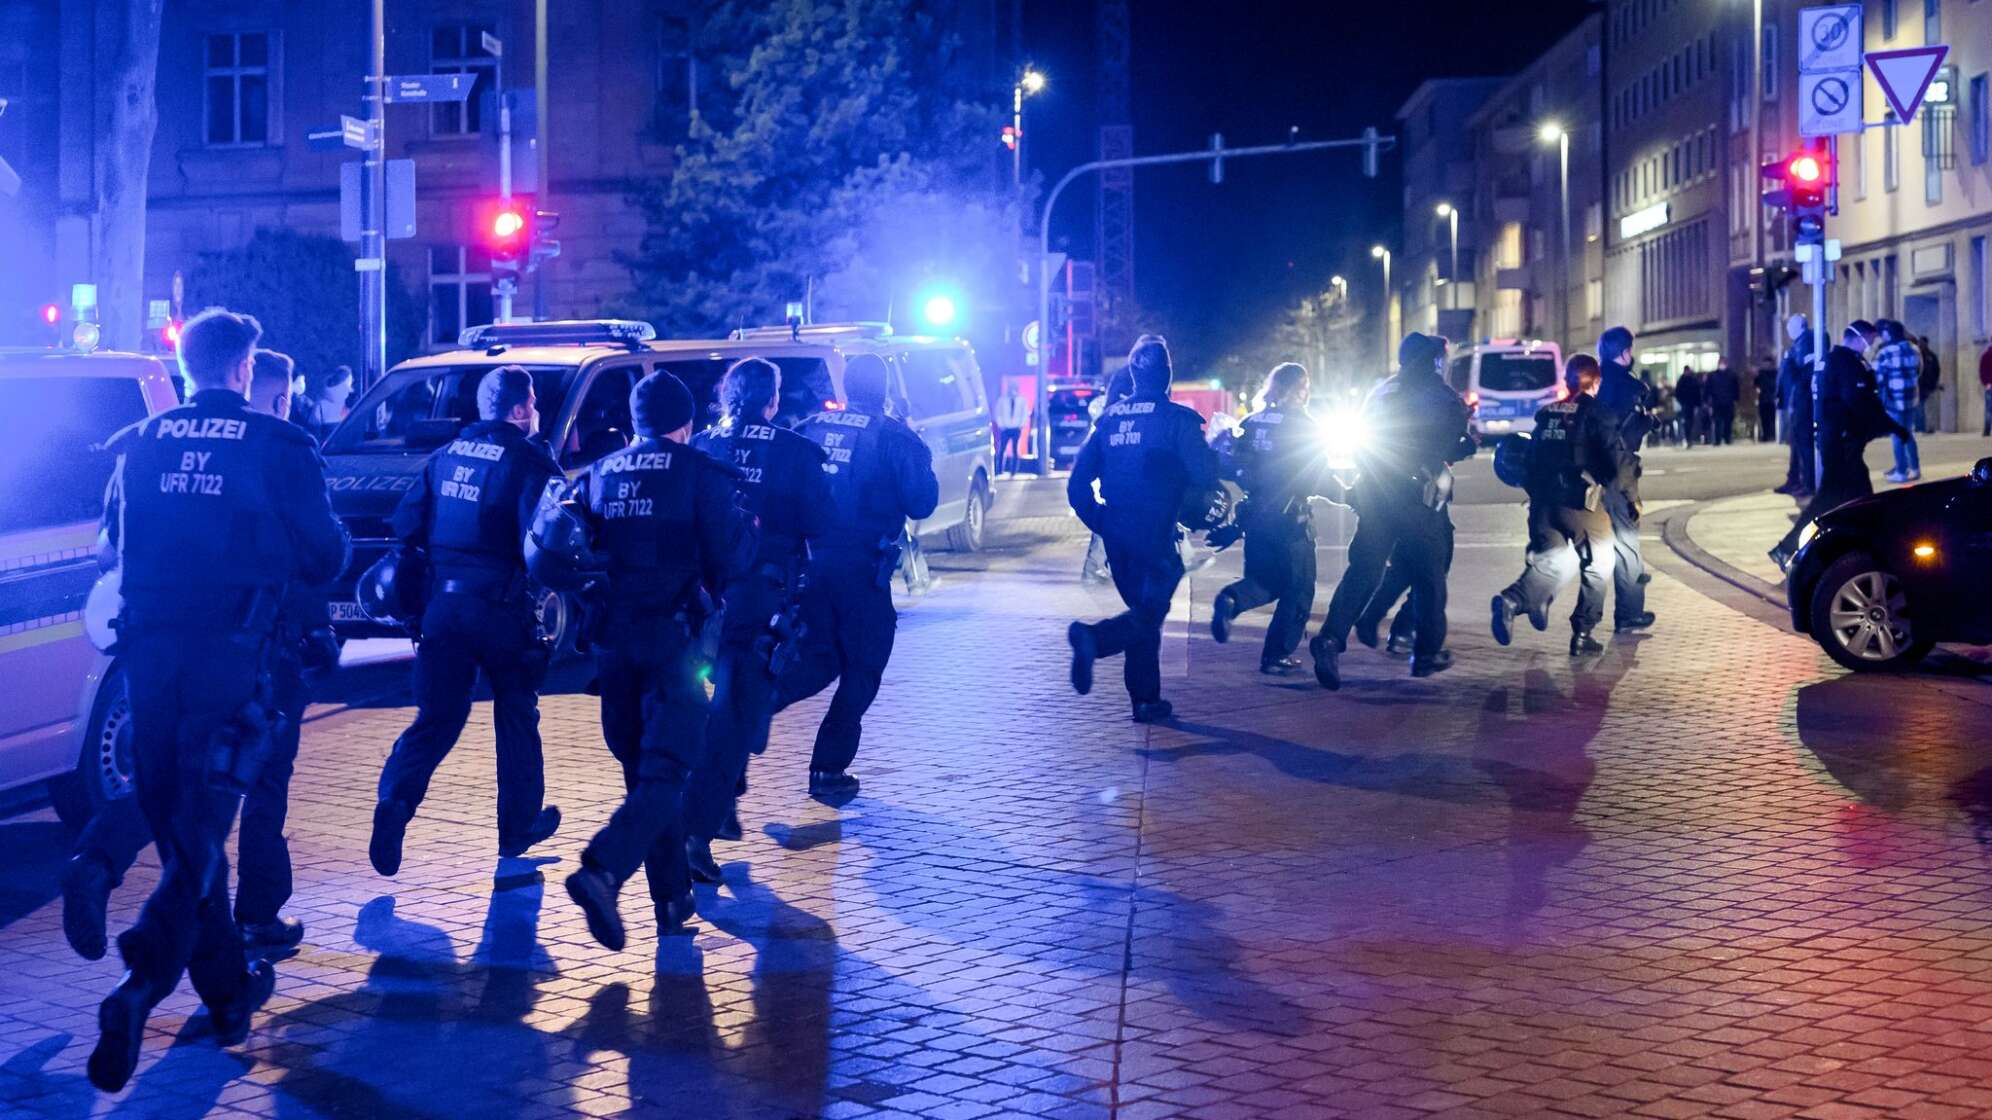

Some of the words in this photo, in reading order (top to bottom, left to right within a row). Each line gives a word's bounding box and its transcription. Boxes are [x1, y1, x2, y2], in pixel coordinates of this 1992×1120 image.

[1108, 402, 1156, 417] POLIZEI
[156, 418, 247, 440] POLIZEI
[816, 411, 871, 429] POLIZEI
[1119, 420, 1136, 433] BY
[824, 432, 845, 447] BY
[447, 440, 505, 462] POLIZEI
[180, 451, 212, 472] BY
[601, 453, 672, 476] POLIZEI
[453, 465, 475, 483] BY
[161, 473, 189, 494] UFR
[191, 474, 224, 496] 7122
[618, 481, 641, 499] BY
[603, 501, 626, 521] UFR
[628, 499, 653, 517] 7122
